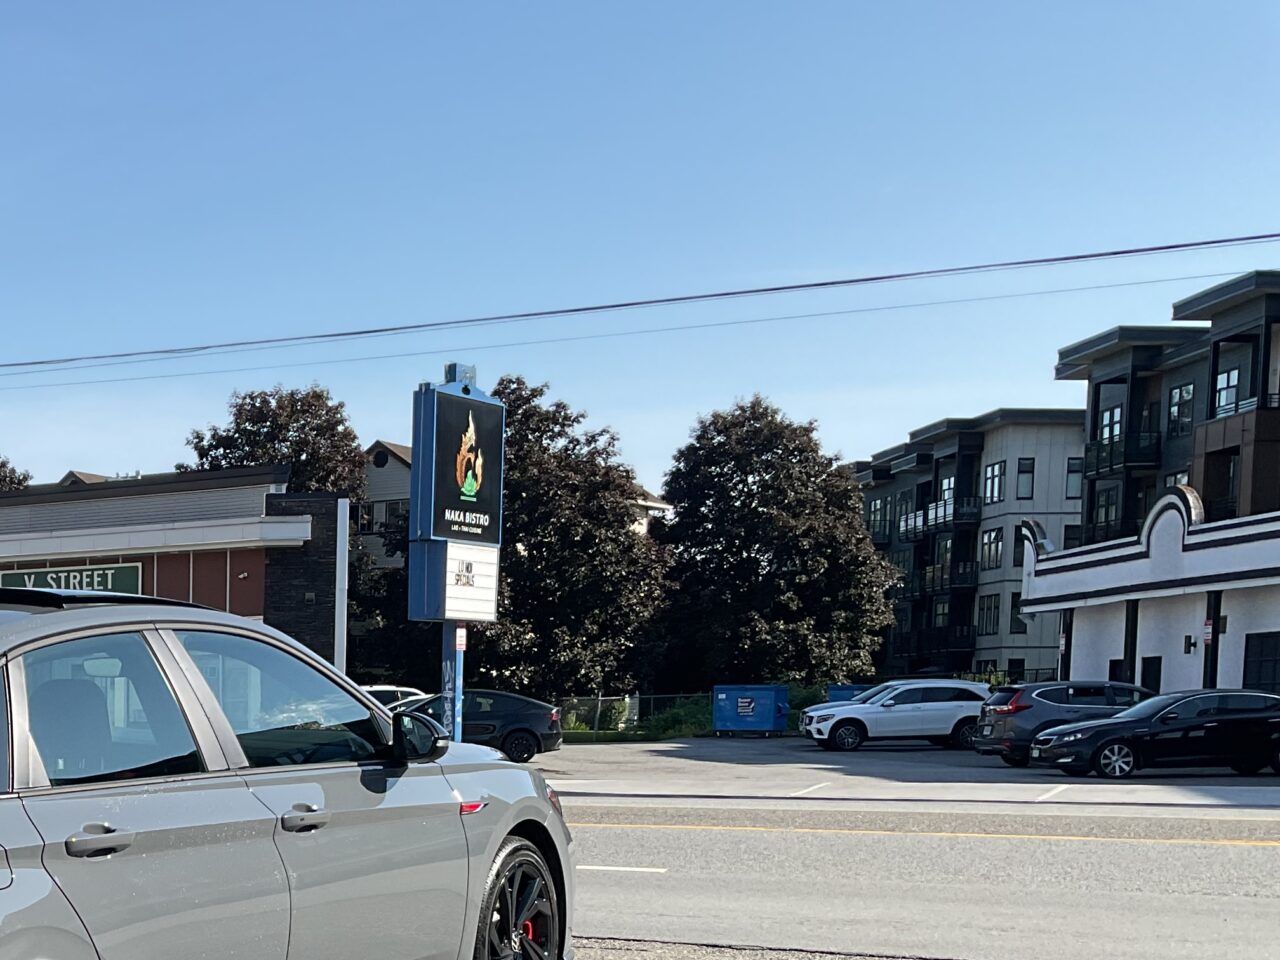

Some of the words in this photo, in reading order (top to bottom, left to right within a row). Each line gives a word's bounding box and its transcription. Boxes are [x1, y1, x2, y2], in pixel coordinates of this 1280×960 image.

[444, 508, 464, 523] NAKA
[465, 511, 490, 526] BISTRO
[46, 569, 116, 591] STREET
